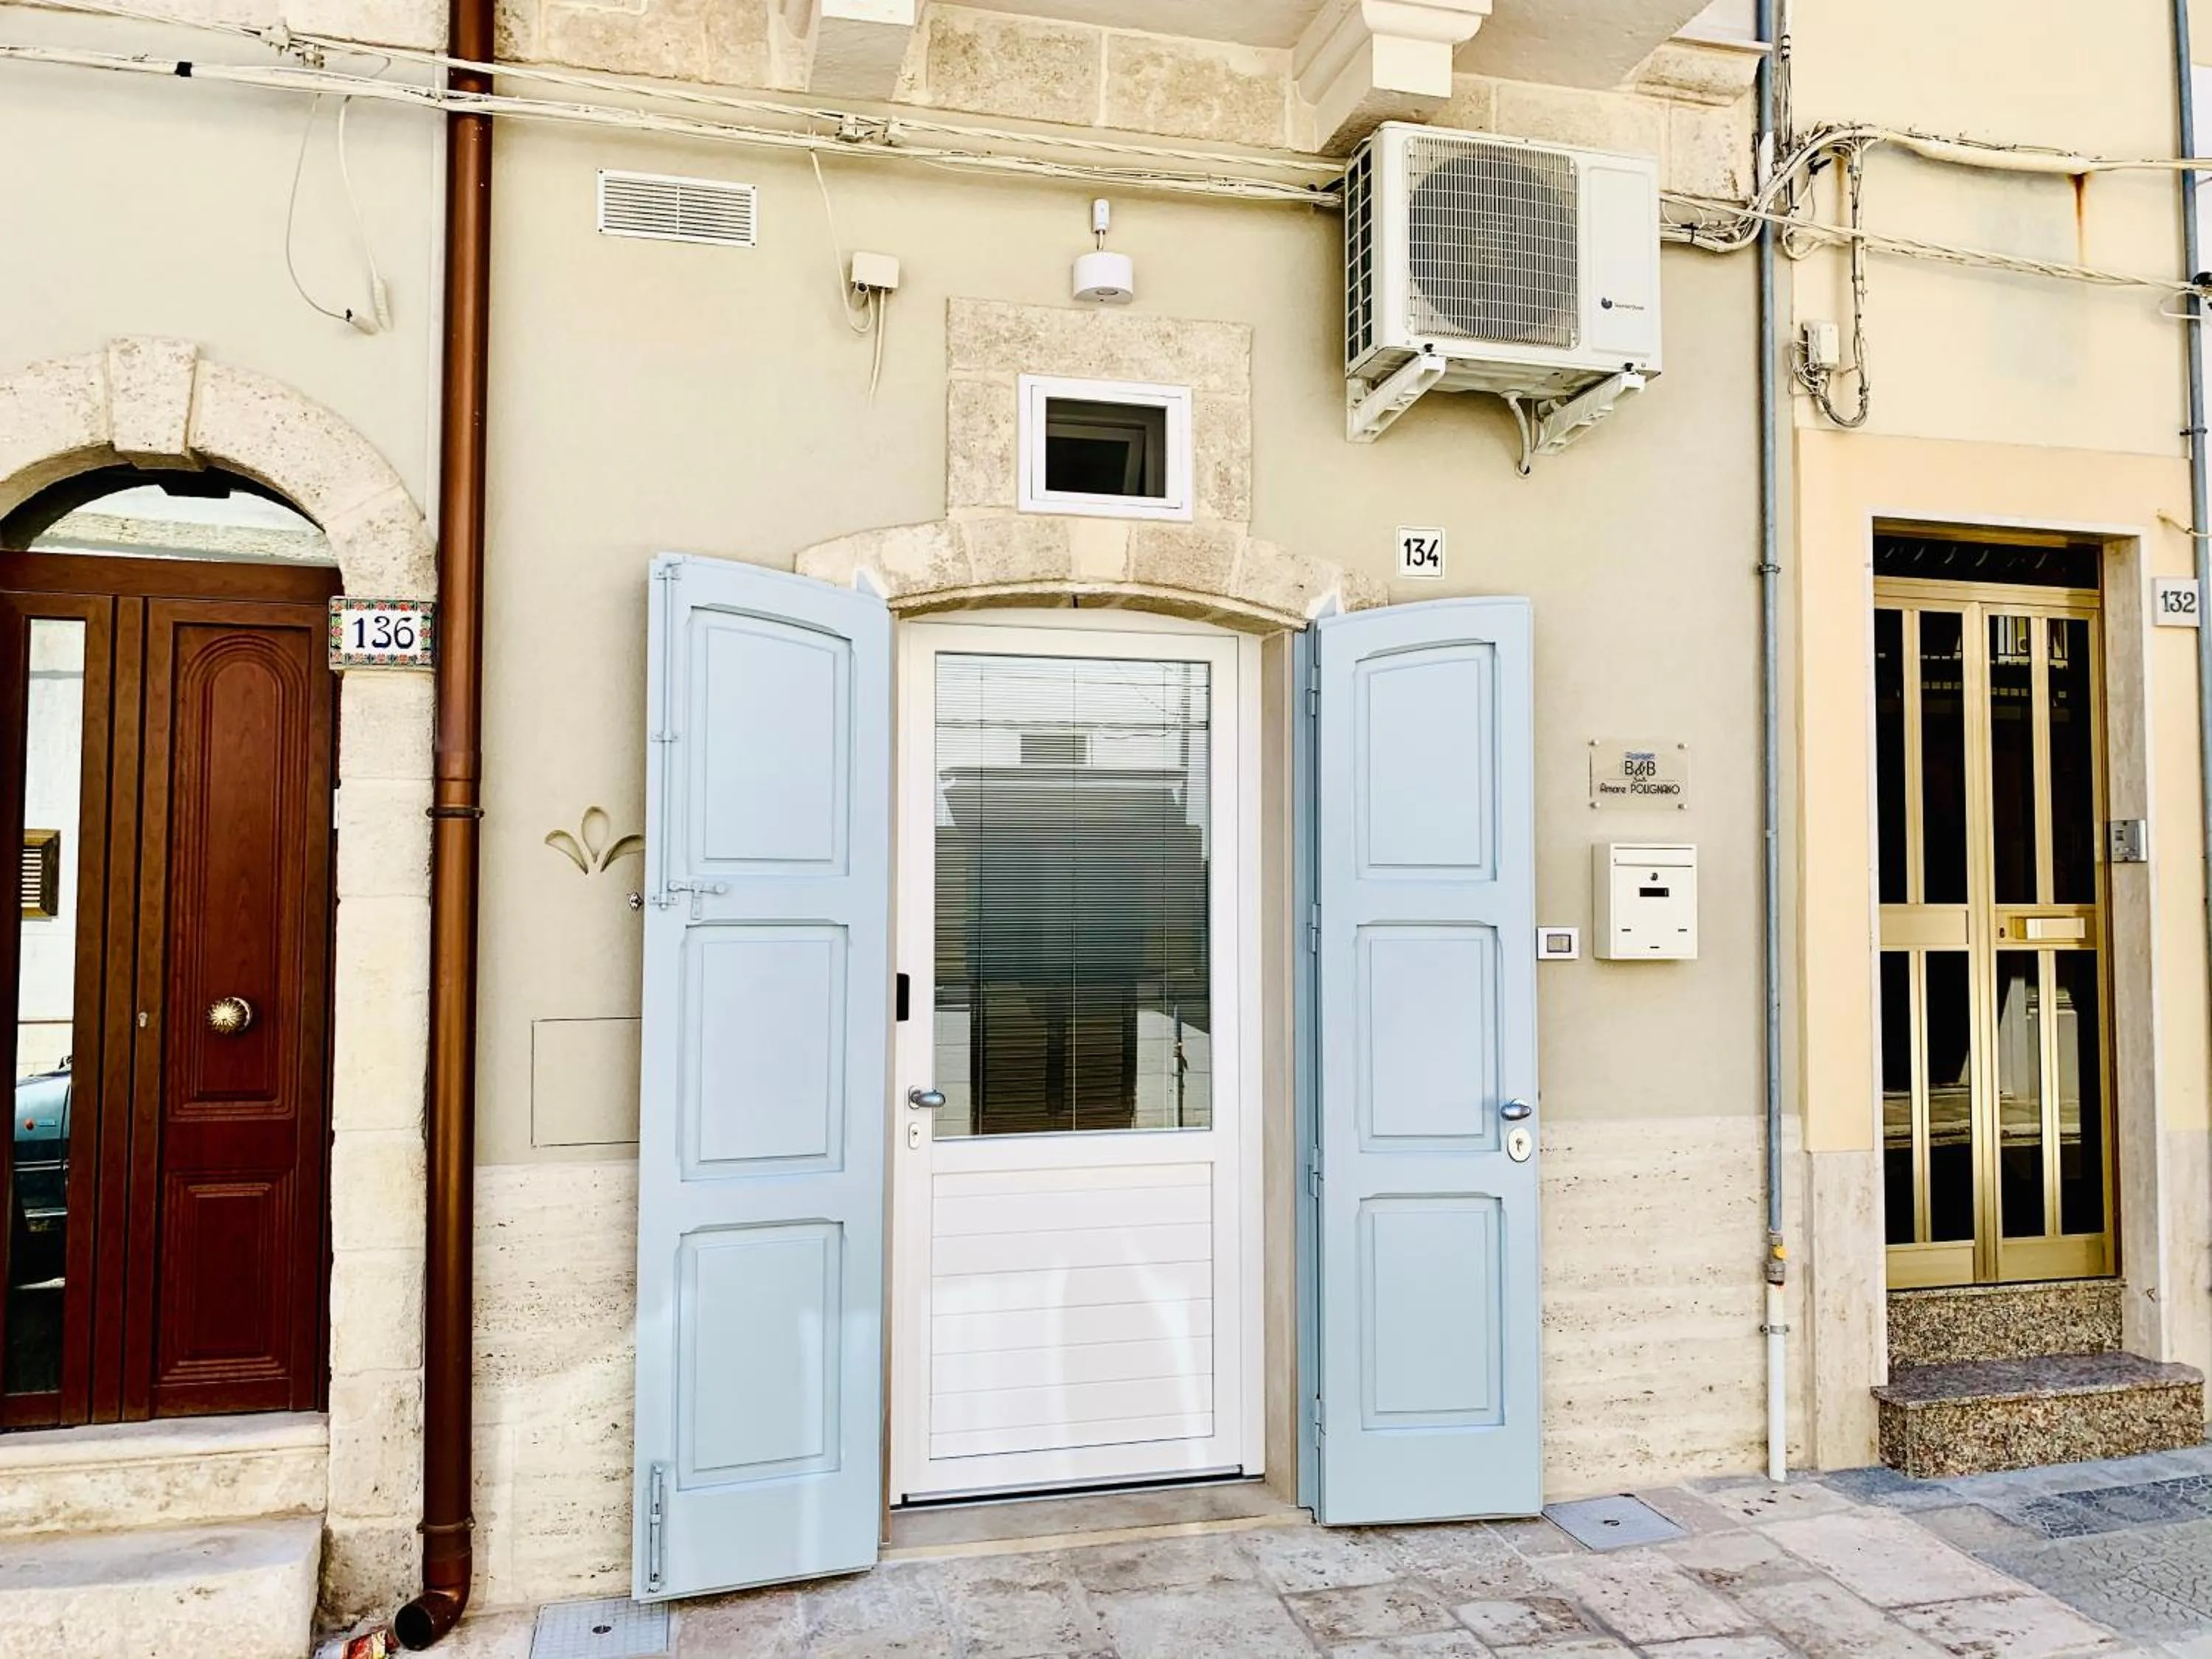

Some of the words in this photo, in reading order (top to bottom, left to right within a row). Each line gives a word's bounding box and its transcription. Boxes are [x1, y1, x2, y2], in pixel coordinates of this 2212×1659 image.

[1403, 538, 1439, 567] 134
[2160, 590, 2196, 613] 132
[352, 616, 414, 649] 136
[1624, 760, 1656, 776] B&B
[1599, 782, 1627, 793] Amore
[1630, 783, 1680, 795] POLIGNANO
